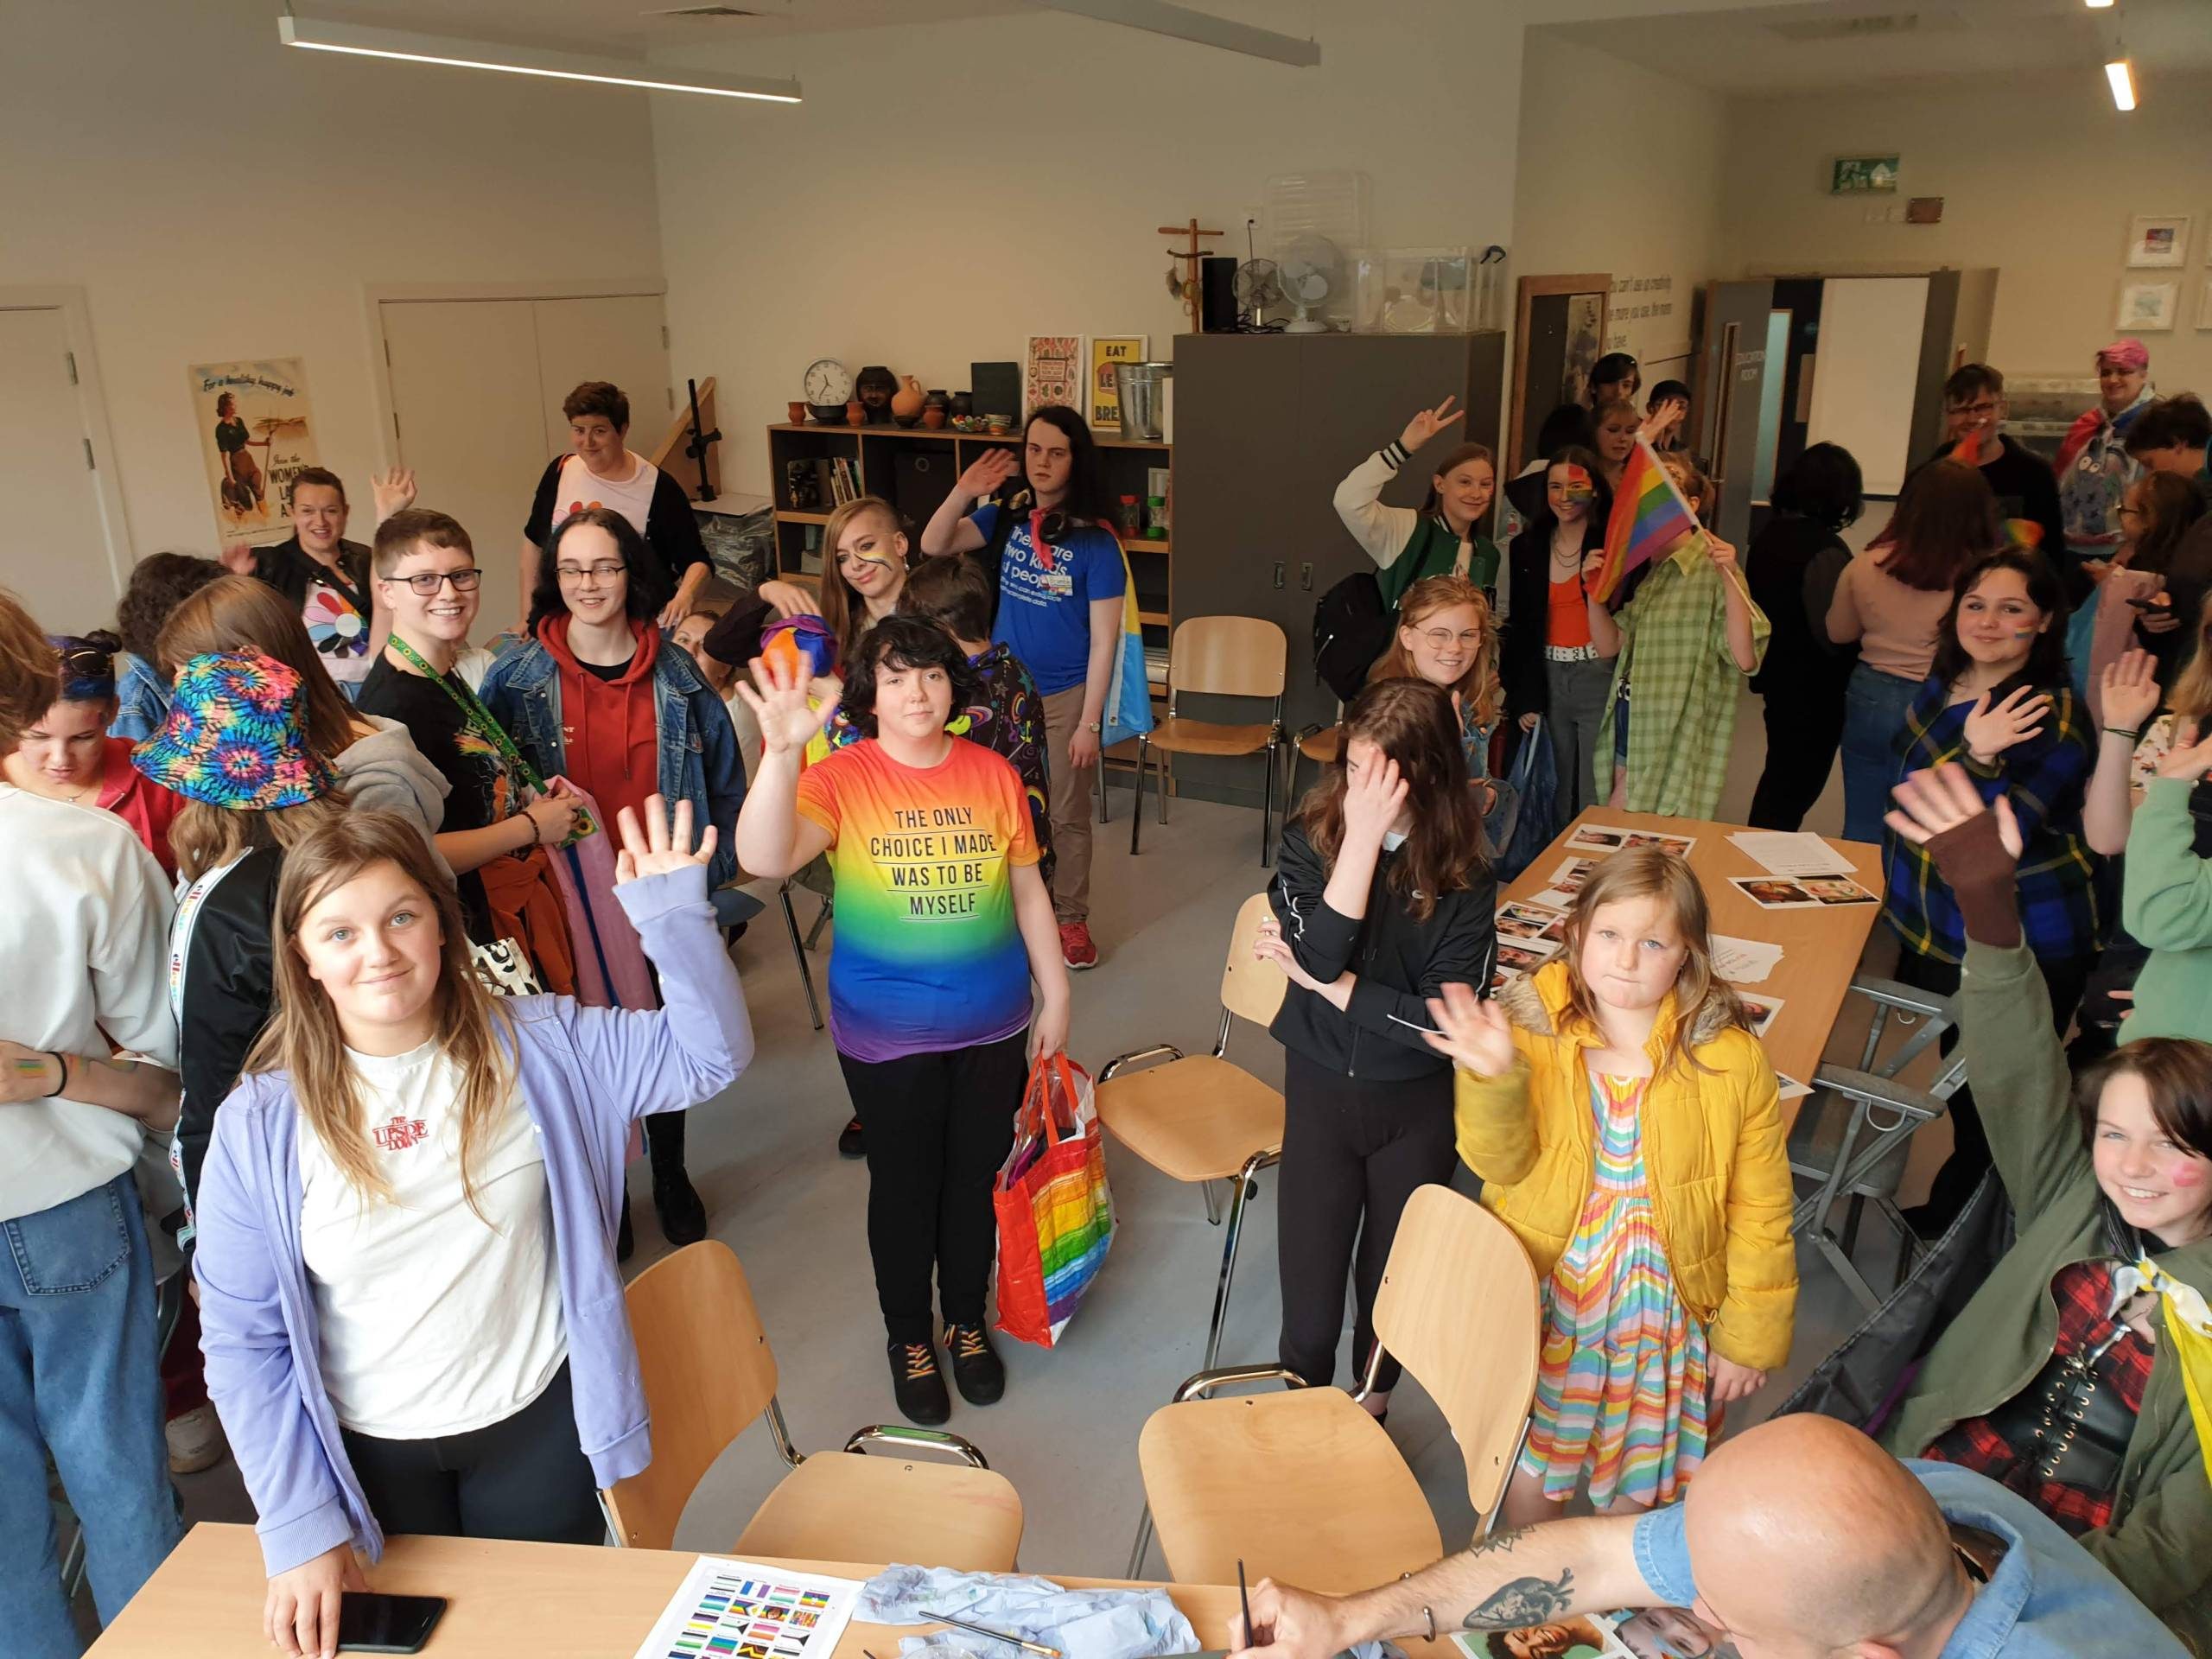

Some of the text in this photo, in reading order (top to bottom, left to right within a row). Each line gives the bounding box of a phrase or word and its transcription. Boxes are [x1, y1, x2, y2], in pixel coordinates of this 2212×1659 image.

[1105, 346, 1127, 357] EAT
[203, 378, 216, 391] For
[1100, 373, 1116, 388] LE
[1095, 405, 1121, 421] BRE
[1010, 525, 1033, 548] The
[1003, 541, 1069, 576] two kids
[1011, 566, 1045, 588] peop
[895, 807, 973, 829] THE ONLY
[871, 834, 997, 858] CHOICE I MADE
[892, 863, 982, 887] WAS TO BE
[910, 893, 976, 915] MYSELF
